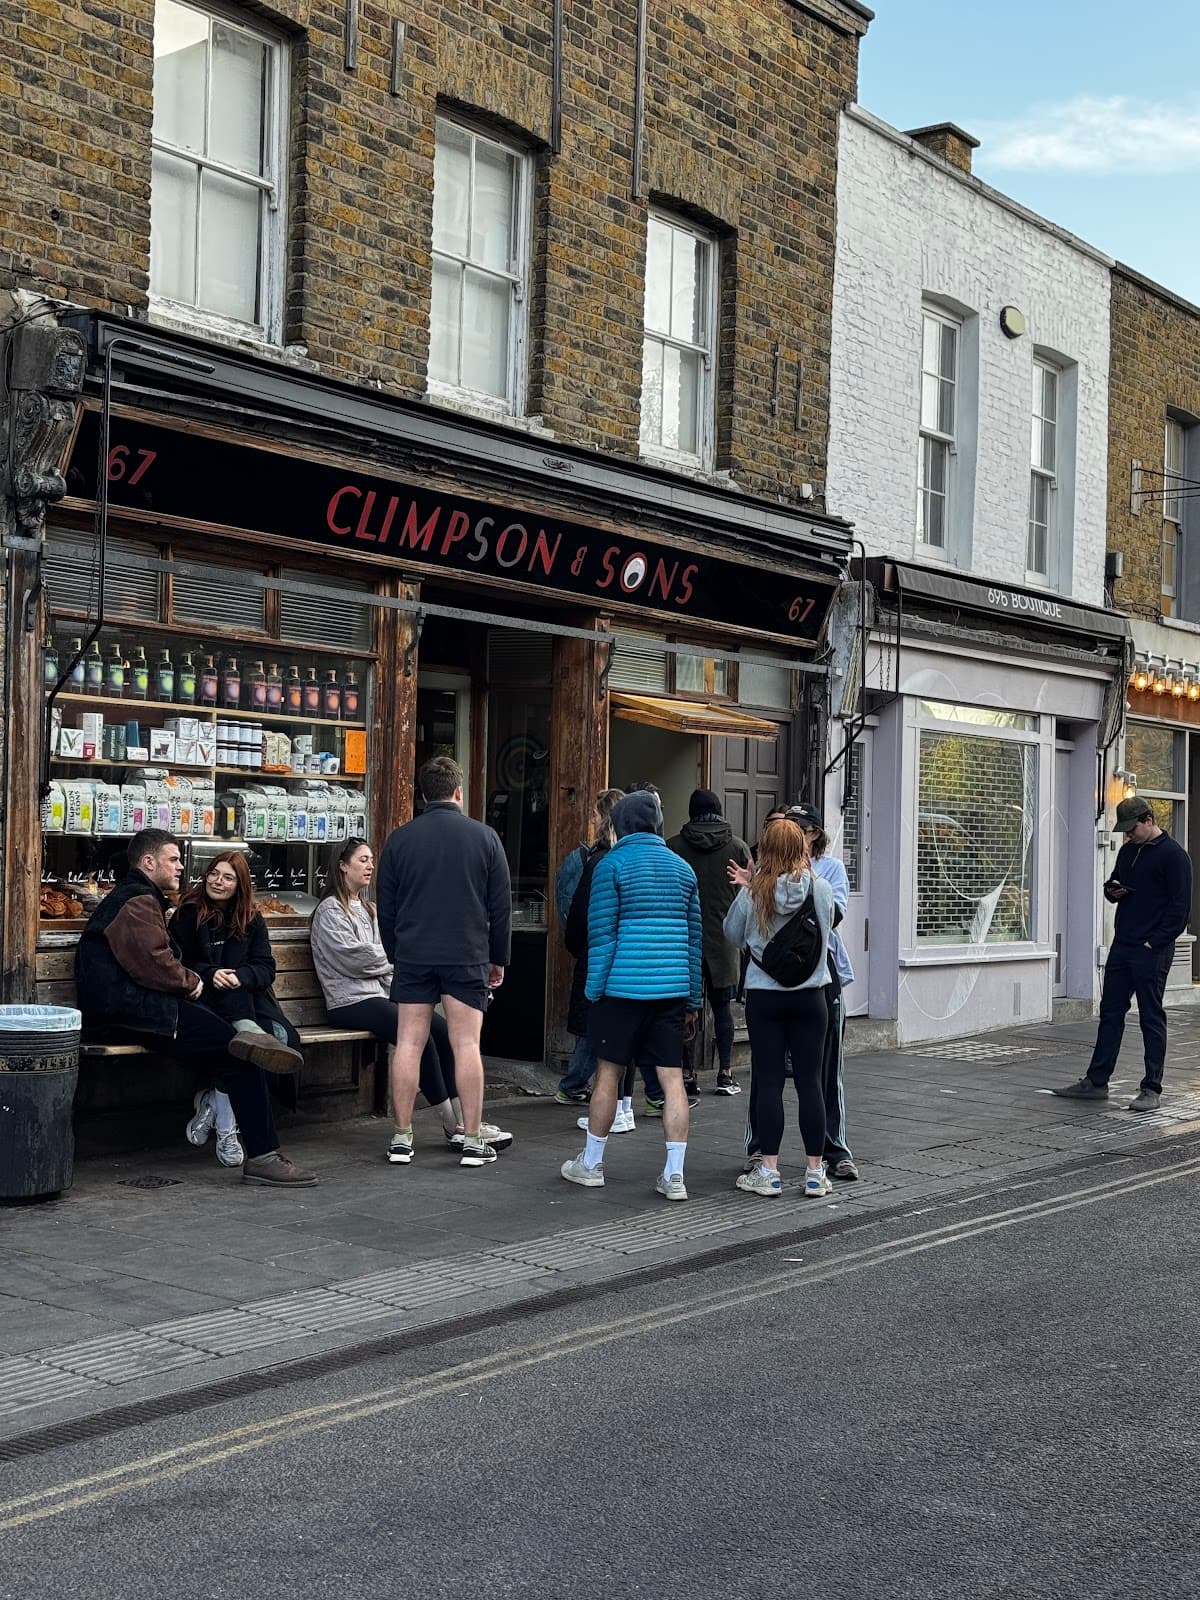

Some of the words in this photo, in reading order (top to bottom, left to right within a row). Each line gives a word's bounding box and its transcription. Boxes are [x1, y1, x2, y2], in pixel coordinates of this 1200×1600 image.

[107, 445, 157, 484] 67
[326, 485, 562, 576] CLIMPSON
[596, 546, 699, 605] SONS
[788, 596, 816, 623] 67
[1011, 592, 1062, 618] BOUTIQUE
